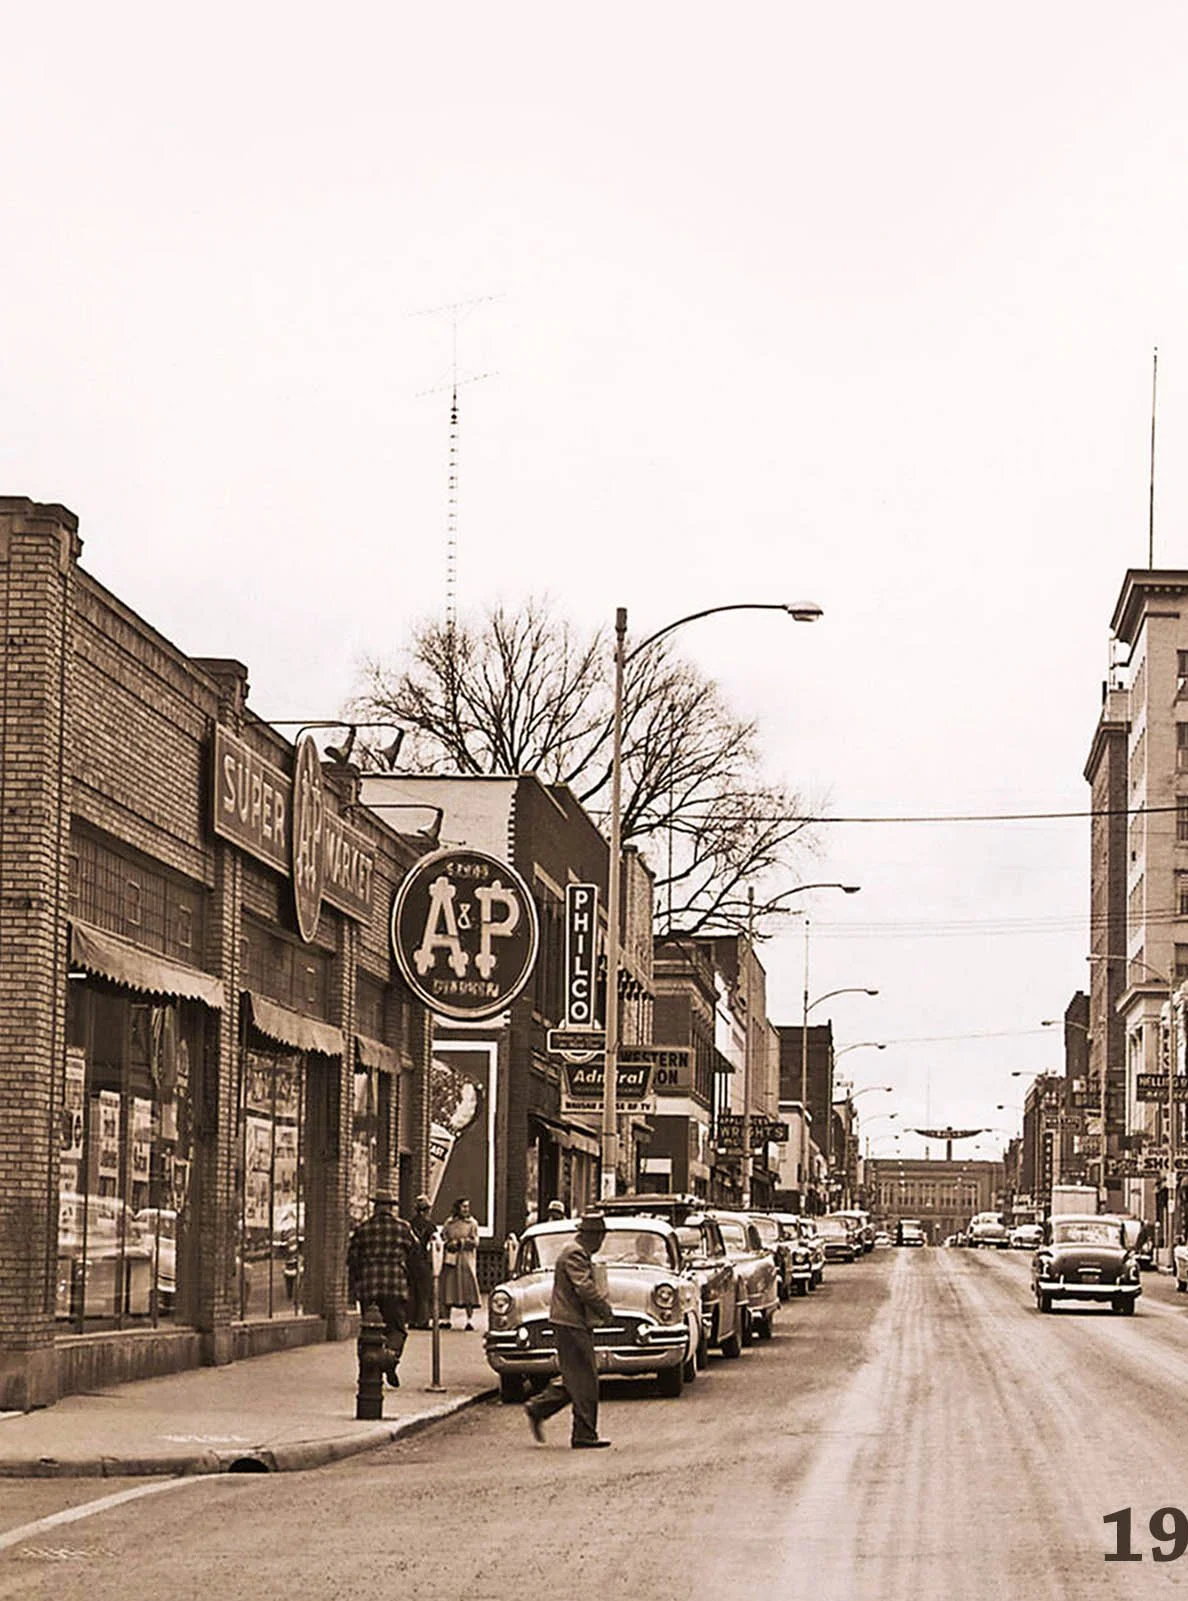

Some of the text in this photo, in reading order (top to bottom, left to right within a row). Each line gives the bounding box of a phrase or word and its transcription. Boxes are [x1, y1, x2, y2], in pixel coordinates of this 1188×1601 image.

[223, 753, 286, 849] SUPER
[413, 876, 520, 979] A&P
[570, 889, 590, 1021] PHILCO
[721, 1126, 785, 1138] WRGHTS
